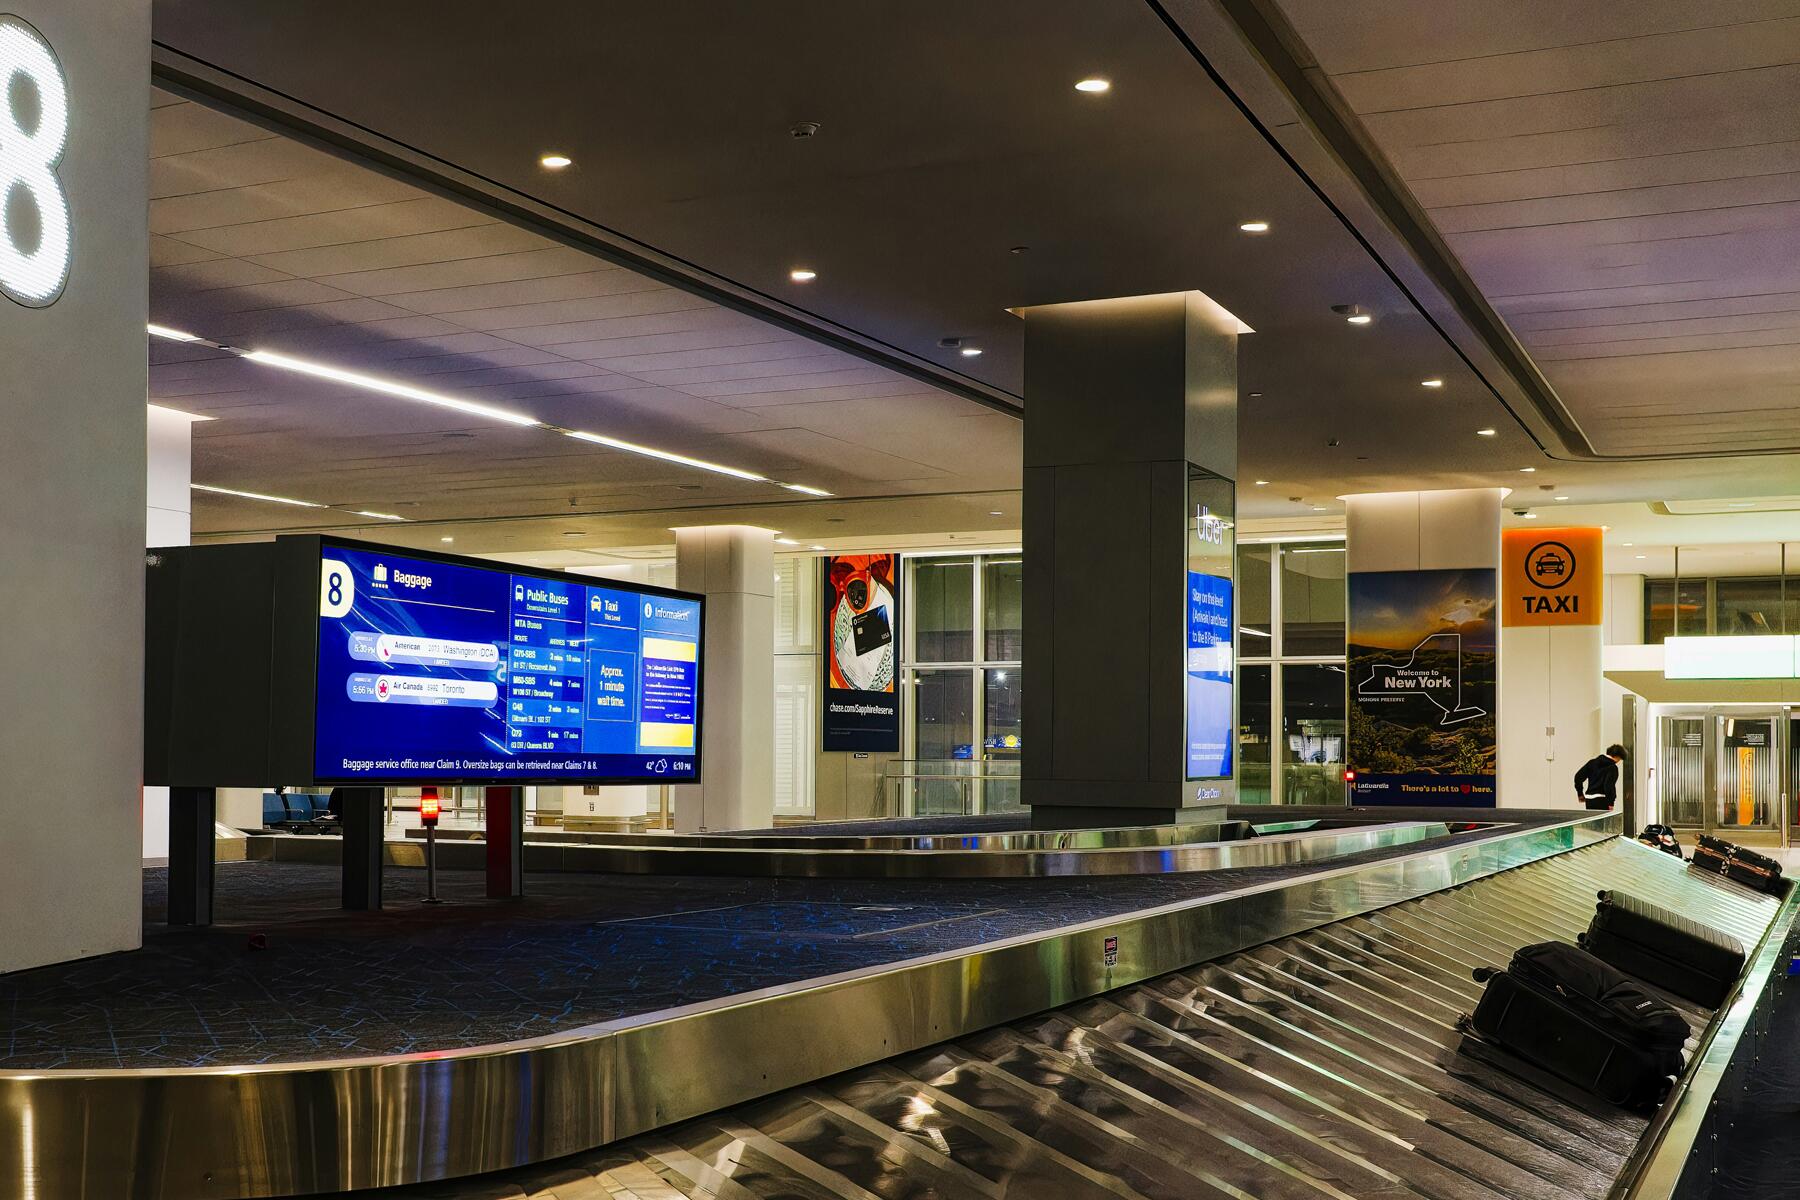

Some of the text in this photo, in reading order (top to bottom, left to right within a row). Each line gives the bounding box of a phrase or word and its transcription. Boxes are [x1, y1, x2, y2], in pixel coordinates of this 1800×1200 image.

[0, 23, 69, 300] 8
[1197, 503, 1224, 545] Uber
[393, 569, 432, 590] Baggage
[328, 572, 343, 606] 8
[527, 589, 569, 606] Public Buses
[1192, 588, 1201, 605] Stay
[1202, 594, 1208, 604] on
[604, 599, 618, 612] Taxi
[1522, 595, 1579, 614] TAXI
[655, 607, 689, 621] Information
[514, 619, 526, 628] MTA
[1192, 630, 1197, 642] to
[394, 641, 420, 651] American
[443, 645, 478, 658] Washington
[600, 664, 624, 678] Approx.
[393, 682, 402, 690] Air
[402, 682, 424, 691] Canada
[442, 683, 465, 694] Toronto
[604, 680, 624, 692] minute
[1384, 676, 1452, 688] New York
[597, 696, 625, 707] wait time.
[829, 702, 894, 716] chase.com/SapphireReserve
[343, 758, 374, 771] Baggage
[375, 758, 399, 769] service
[400, 758, 419, 769] office
[420, 761, 435, 769] near
[436, 759, 454, 769] Claim
[456, 760, 461, 769] 9.
[462, 759, 489, 769] Oversize
[490, 760, 504, 771] bags
[505, 761, 516, 770] can
[516, 760, 524, 770] be
[525, 760, 551, 770] retrieved
[551, 761, 564, 770] near
[564, 760, 582, 770] Claims
[582, 761, 587, 770] 7
[587, 761, 592, 770] &
[684, 762, 692, 770] PM
[1401, 784, 1430, 792] There's
